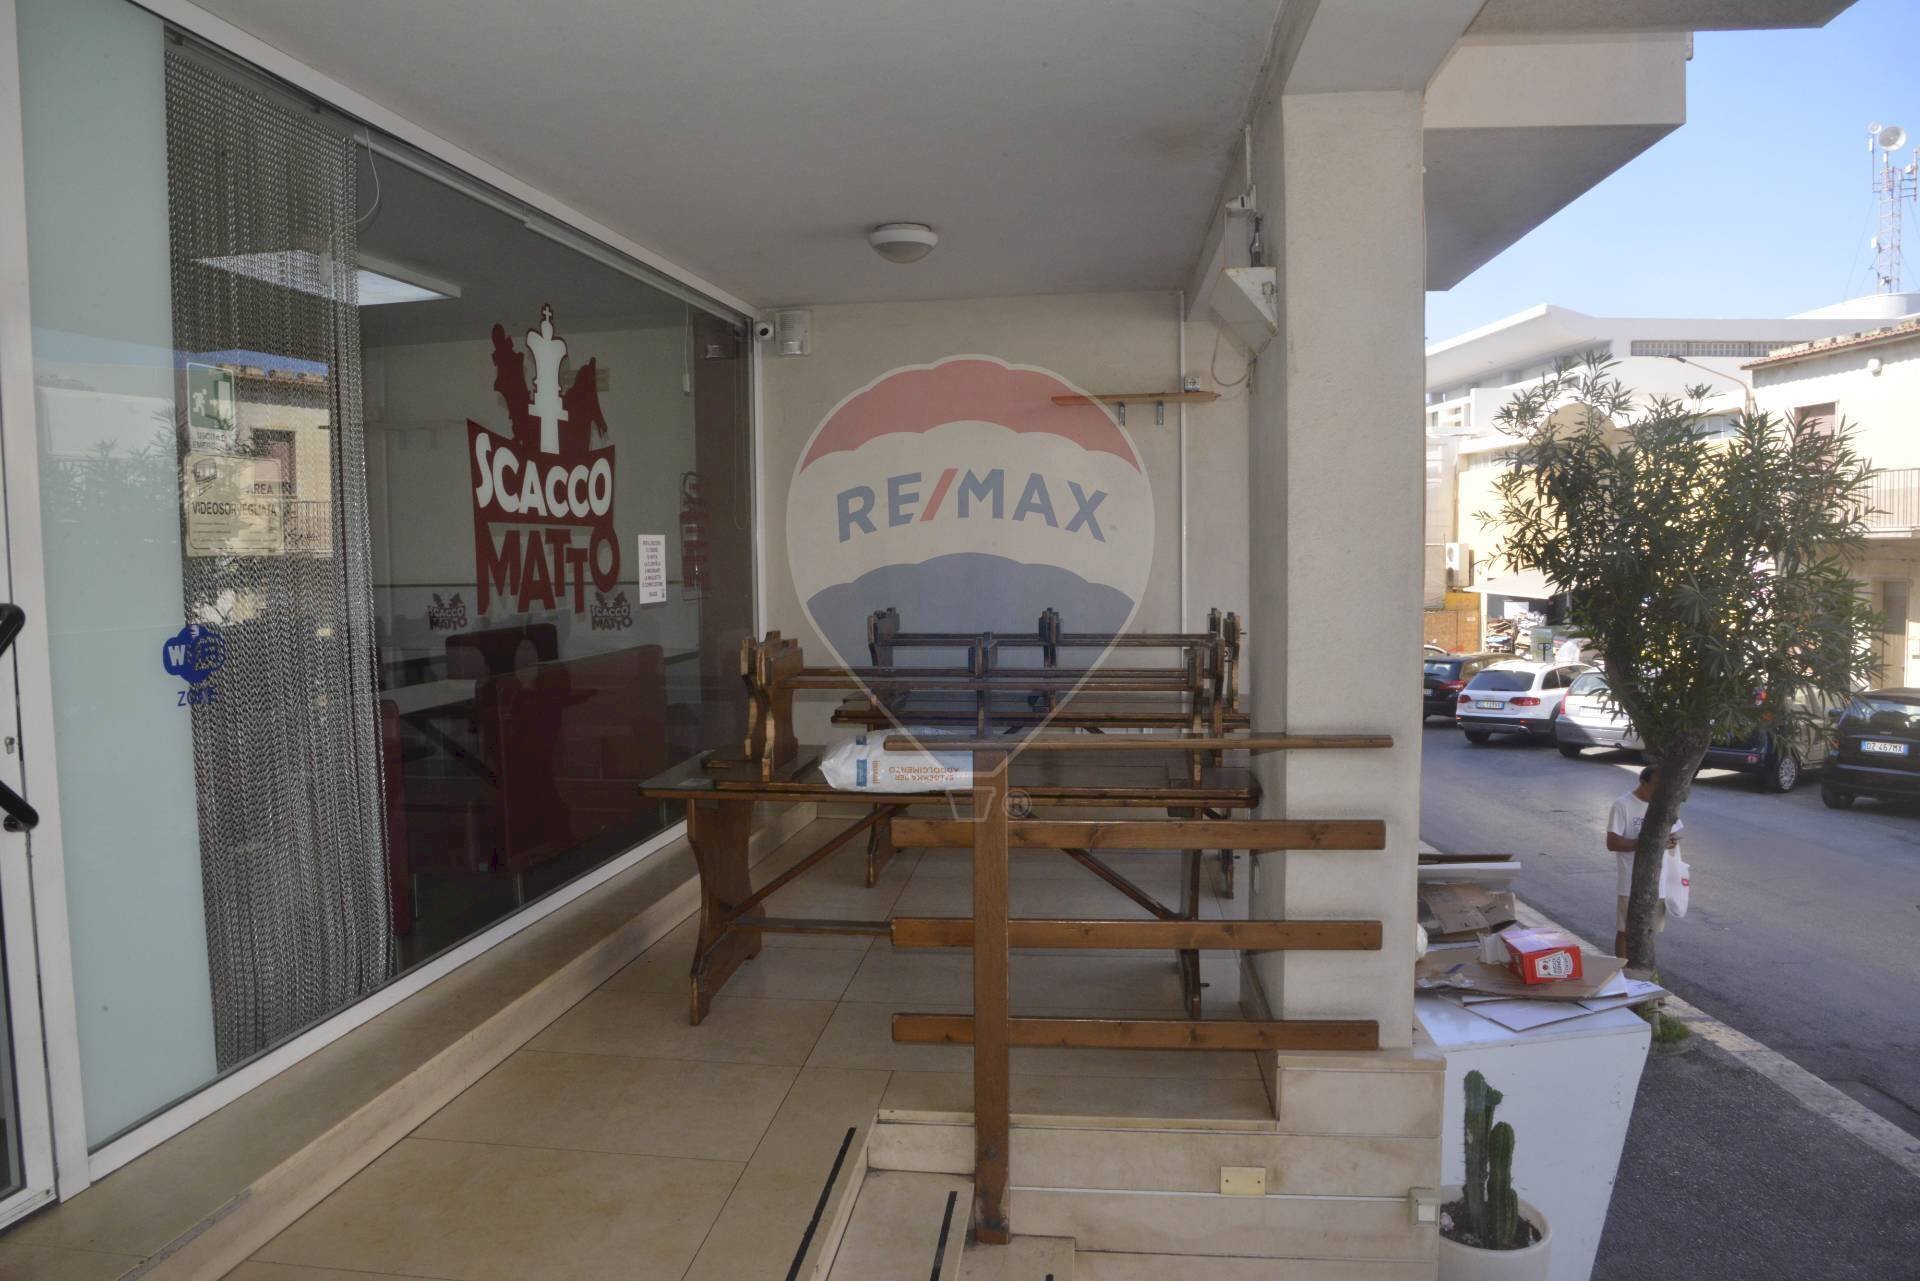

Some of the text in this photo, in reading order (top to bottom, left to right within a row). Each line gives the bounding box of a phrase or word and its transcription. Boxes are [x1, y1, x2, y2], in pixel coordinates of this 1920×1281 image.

[476, 432, 612, 518] SCACCO
[246, 482, 273, 495] AREA
[477, 522, 620, 616] MATTO
[429, 605, 465, 617] SCACCO
[591, 605, 629, 617] SCACCO
[429, 616, 468, 631] MATTO
[591, 616, 633, 631] MATTO
